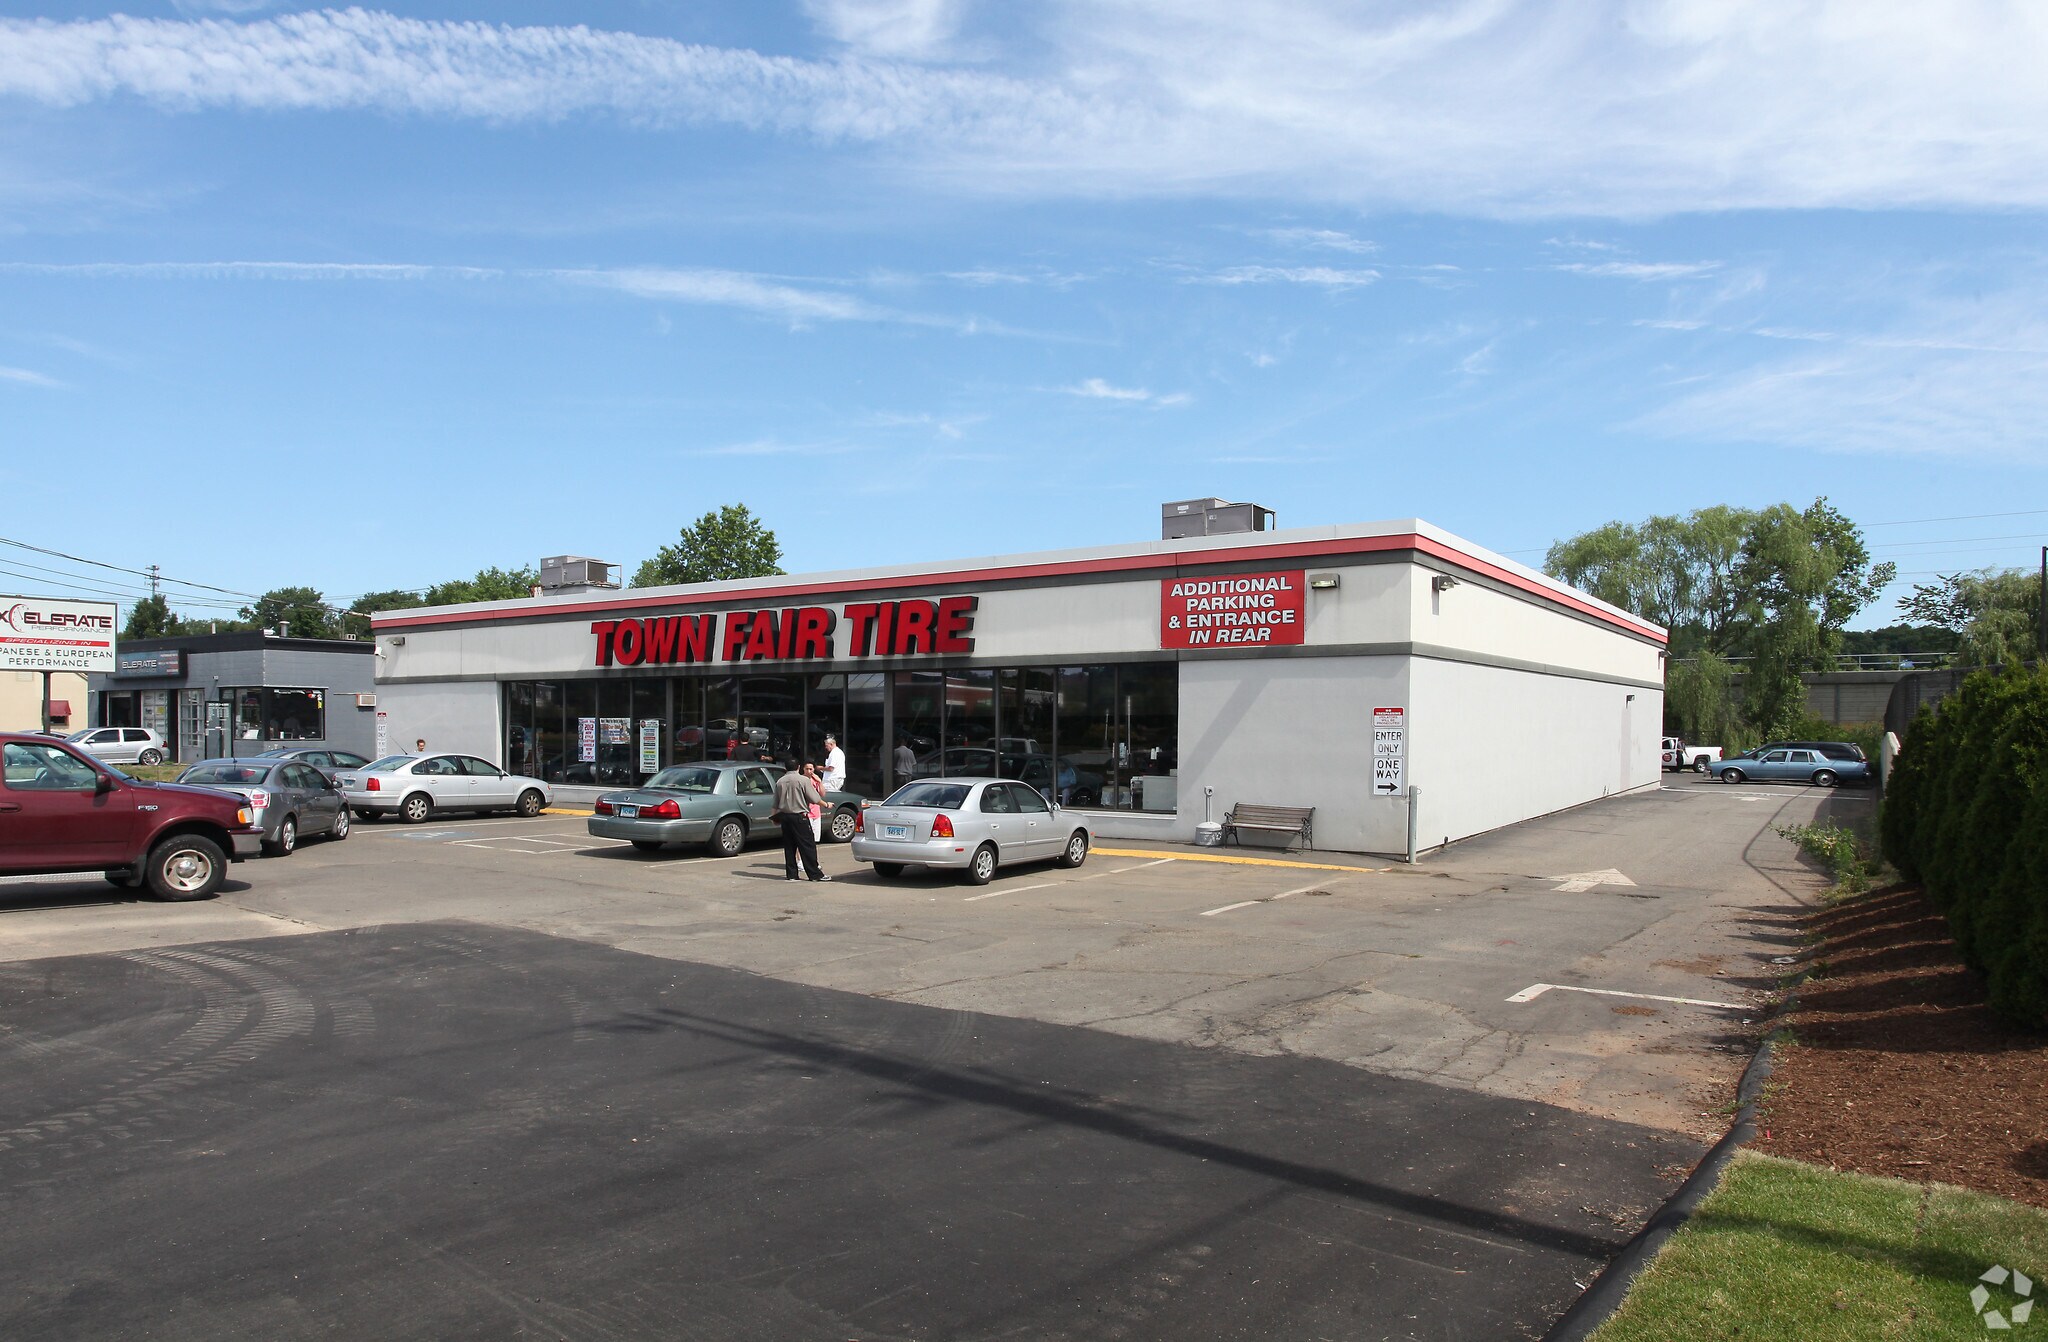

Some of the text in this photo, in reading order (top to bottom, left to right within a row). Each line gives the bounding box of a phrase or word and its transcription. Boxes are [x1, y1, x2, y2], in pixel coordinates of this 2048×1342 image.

[1170, 576, 1292, 597] ADDITIONAL
[1186, 593, 1275, 612] PARKING
[1168, 609, 1295, 629] & ENTRANCE
[31, 625, 112, 634] PERFORMANCE
[590, 595, 979, 666] TOWN FAIR TIRE
[1188, 627, 1271, 644] IN REAR
[5, 637, 77, 646] SPECIALIZING
[56, 649, 113, 659] EUROPEAN
[8, 657, 90, 668] PERFORMANCE
[1375, 731, 1402, 741] ENTER
[1378, 744, 1399, 753] ONLY
[1377, 760, 1400, 769] ONE
[1376, 770, 1400, 779] WAY
